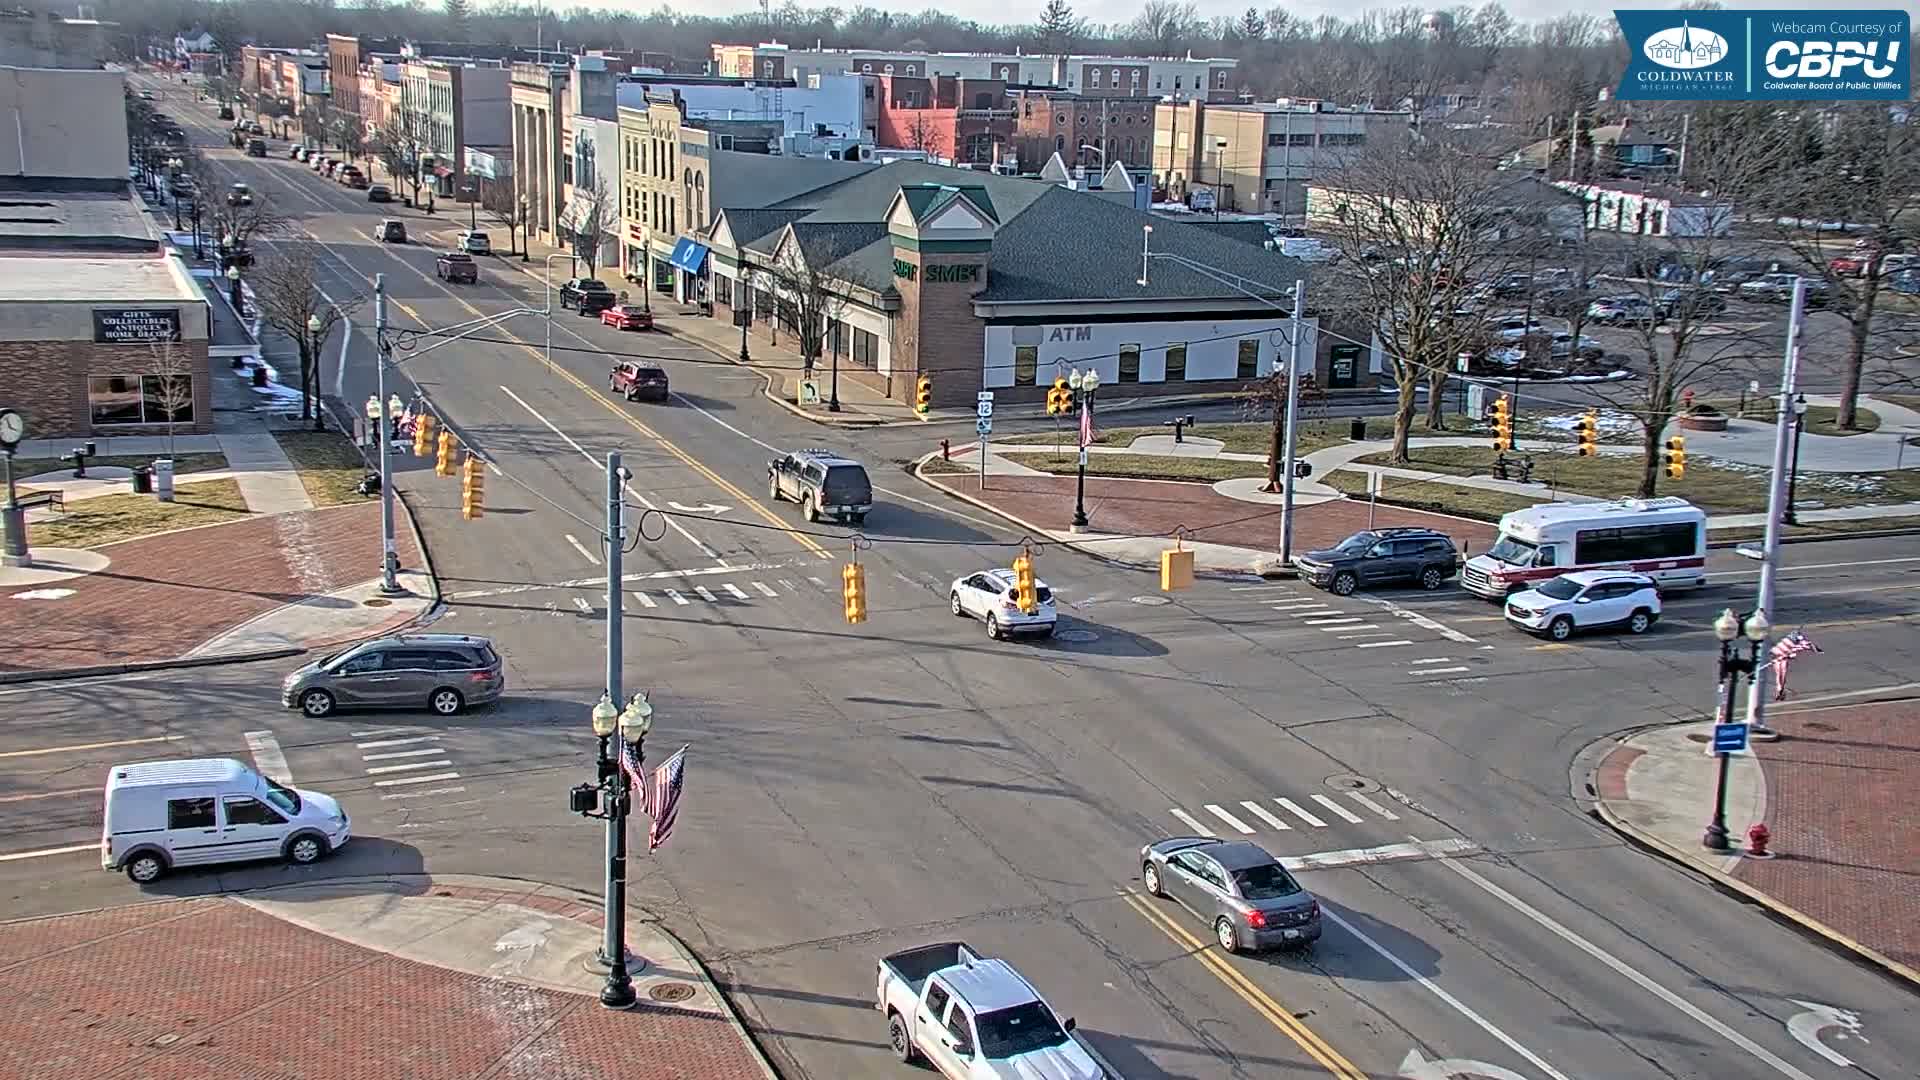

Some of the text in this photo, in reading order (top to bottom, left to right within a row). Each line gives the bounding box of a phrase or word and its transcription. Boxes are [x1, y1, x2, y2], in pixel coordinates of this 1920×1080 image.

[115, 324, 161, 332] ANTIQUES
[1049, 326, 1092, 342] ATM
[980, 404, 990, 414] 12
